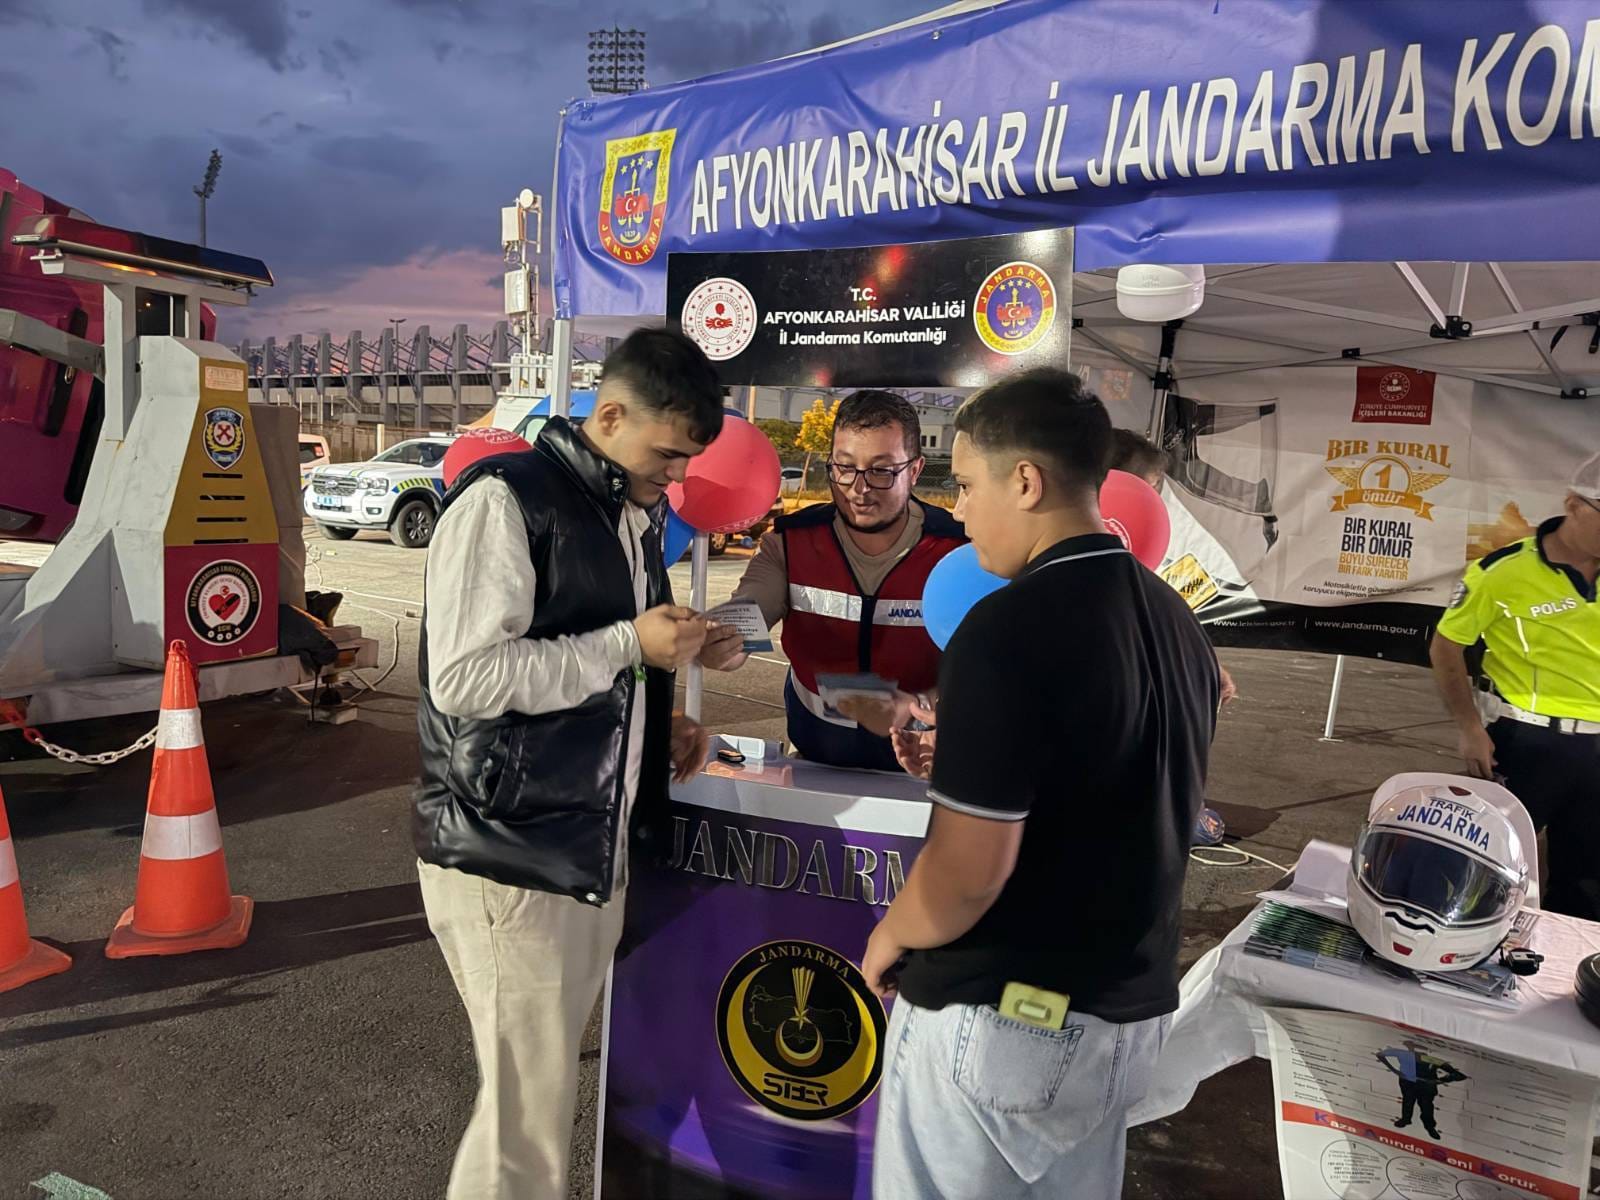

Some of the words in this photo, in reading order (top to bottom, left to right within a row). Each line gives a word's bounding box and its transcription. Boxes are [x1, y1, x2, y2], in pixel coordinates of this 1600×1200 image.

[690, 100, 1026, 235] AFYONKARAHİSAR
[1036, 81, 1077, 194] İL
[1088, 44, 1430, 186] JANDARMA
[602, 218, 661, 261] JANDARMA
[850, 287, 877, 301] T.C.
[981, 266, 1050, 304] JANDARMA
[763, 306, 899, 325] AFYONKARAHİSAR
[903, 300, 966, 320] VALİLİĞİ
[779, 329, 787, 345] İl
[790, 330, 860, 345] Jandarma
[863, 327, 946, 345] Komutanlığı
[1376, 440, 1452, 469] KURAL
[1375, 463, 1392, 488] 1
[1361, 489, 1405, 505] ömür
[1368, 519, 1414, 540] KURAL
[1339, 553, 1364, 567] BOYU
[1352, 565, 1372, 577] FARK
[888, 607, 924, 618] JANDA
[1314, 620, 1418, 636] www.jandarma.gov.tr
[1397, 805, 1490, 851] JANDARMA
[760, 945, 849, 978] JANDARMA
[1314, 1110, 1357, 1134] Kaza
